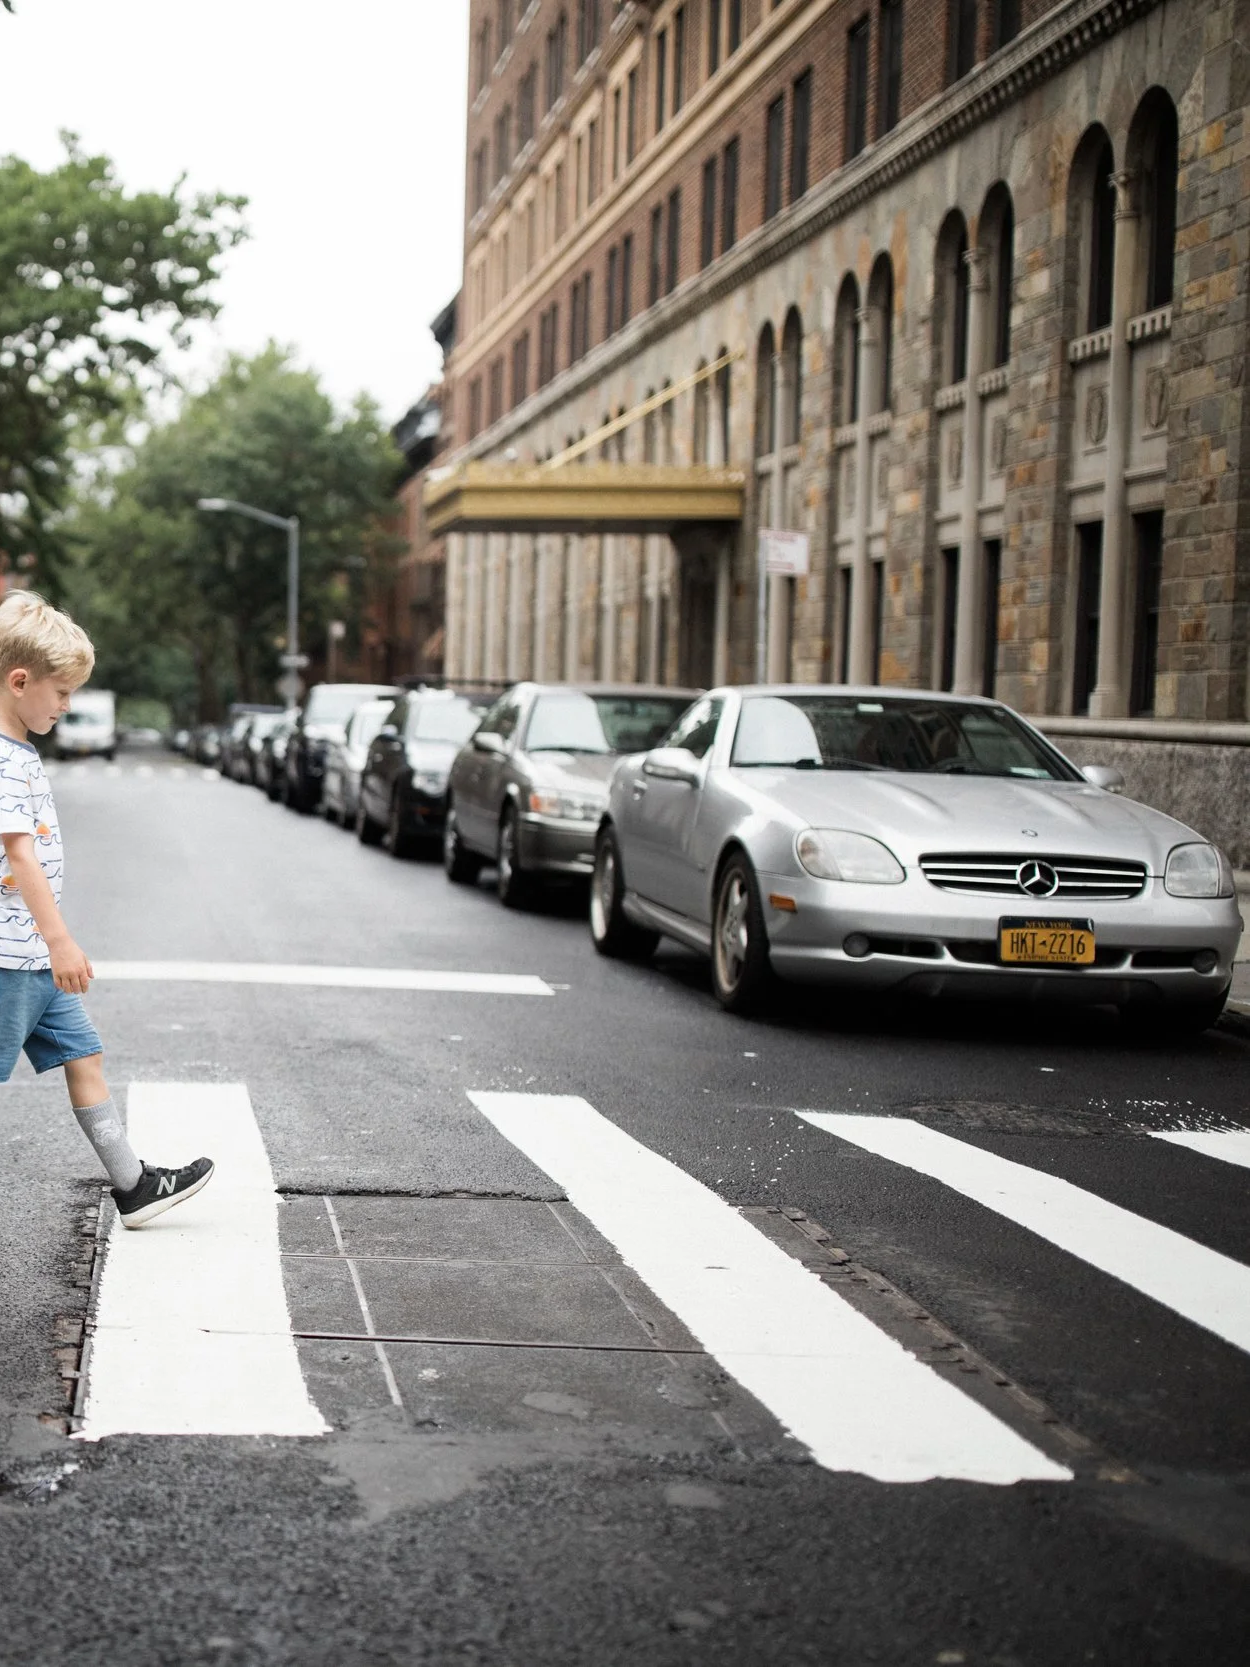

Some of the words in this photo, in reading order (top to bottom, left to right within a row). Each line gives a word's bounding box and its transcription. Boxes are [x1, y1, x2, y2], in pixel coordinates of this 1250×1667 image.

[1025, 920, 1048, 929] NEW
[1050, 921, 1072, 930] YORK
[1010, 932, 1038, 954] HKT
[1049, 933, 1086, 955] 2216
[156, 1175, 177, 1196] N
